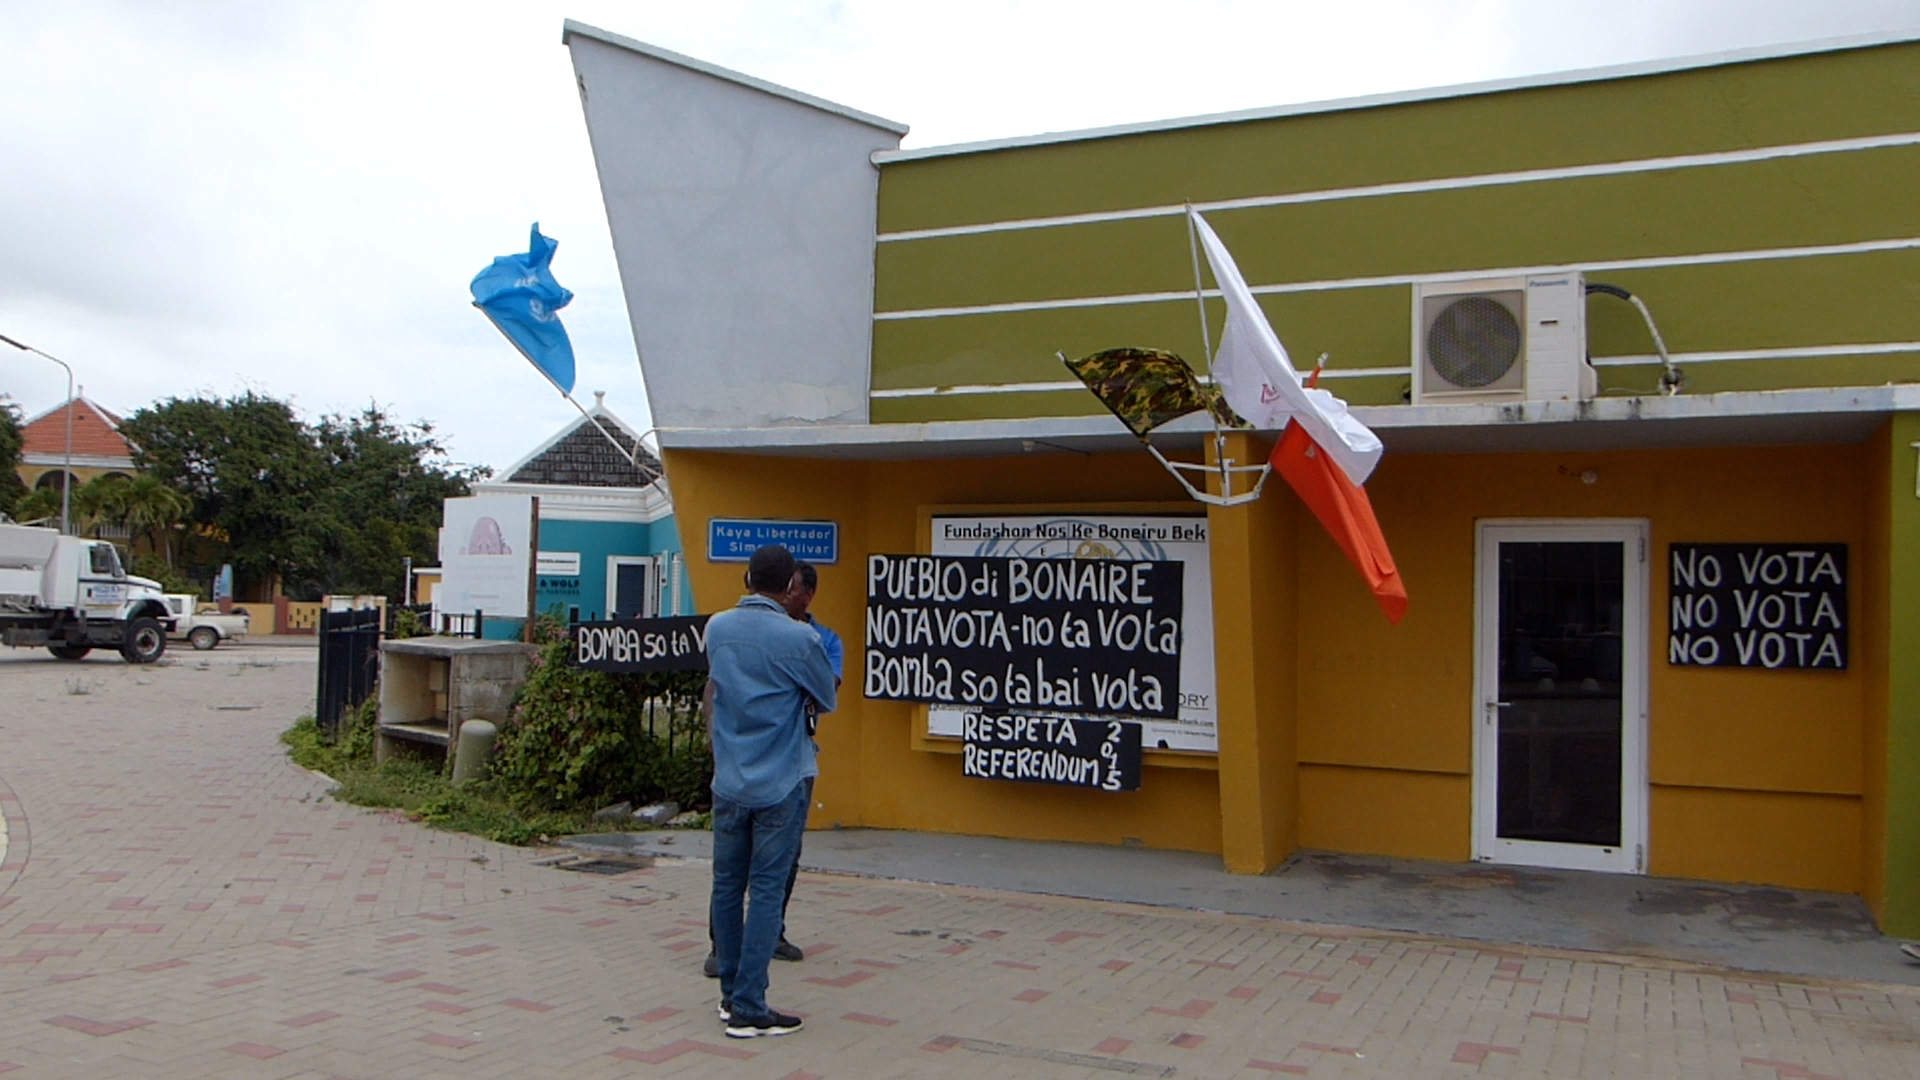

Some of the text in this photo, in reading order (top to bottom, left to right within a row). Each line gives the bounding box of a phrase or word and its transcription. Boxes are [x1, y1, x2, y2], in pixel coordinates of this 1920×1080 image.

[716, 526, 831, 539] Kaya Libertador
[944, 523, 1206, 541] Fundashon Nos Ke Boneiru Bek
[868, 555, 967, 601] PUEBLO
[971, 562, 998, 598] di
[1673, 548, 1842, 588] NO VOTA
[1060, 611, 1091, 648] ta
[1672, 589, 1841, 631] NO VOTA
[578, 626, 640, 663] BOMBA
[1670, 629, 1842, 668] NO VOTA
[961, 669, 998, 702] so
[1004, 663, 1031, 705] ta
[1036, 657, 1083, 706] bai
[964, 714, 1077, 746] RESPETA
[963, 743, 1099, 786] REFERENDUM
